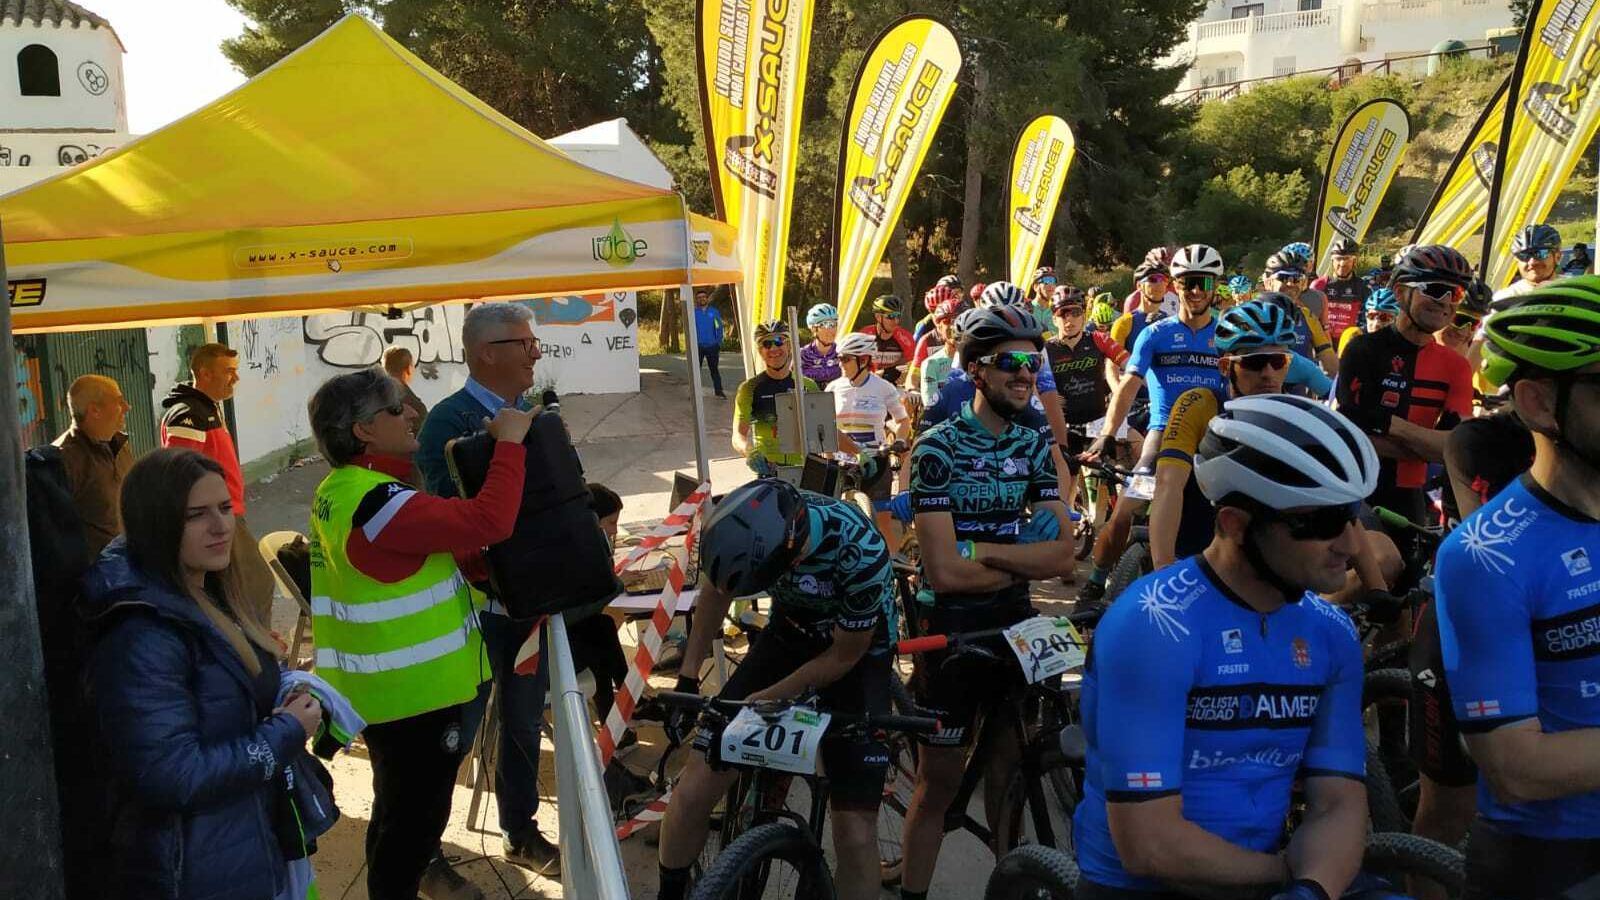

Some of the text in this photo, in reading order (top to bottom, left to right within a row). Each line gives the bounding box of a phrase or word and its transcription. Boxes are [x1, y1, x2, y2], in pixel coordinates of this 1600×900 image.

[732, 12, 749, 73] CAMARAS
[729, 74, 743, 108] PARA
[870, 60, 942, 202] X-SAUCE
[1031, 138, 1064, 219] X-SAUCE
[1346, 129, 1396, 223] X-SAUCE
[248, 243, 397, 263] www.x-sauce.com
[919, 496, 950, 506] FASTE
[1040, 488, 1060, 498] FAS
[742, 723, 805, 755] 201
